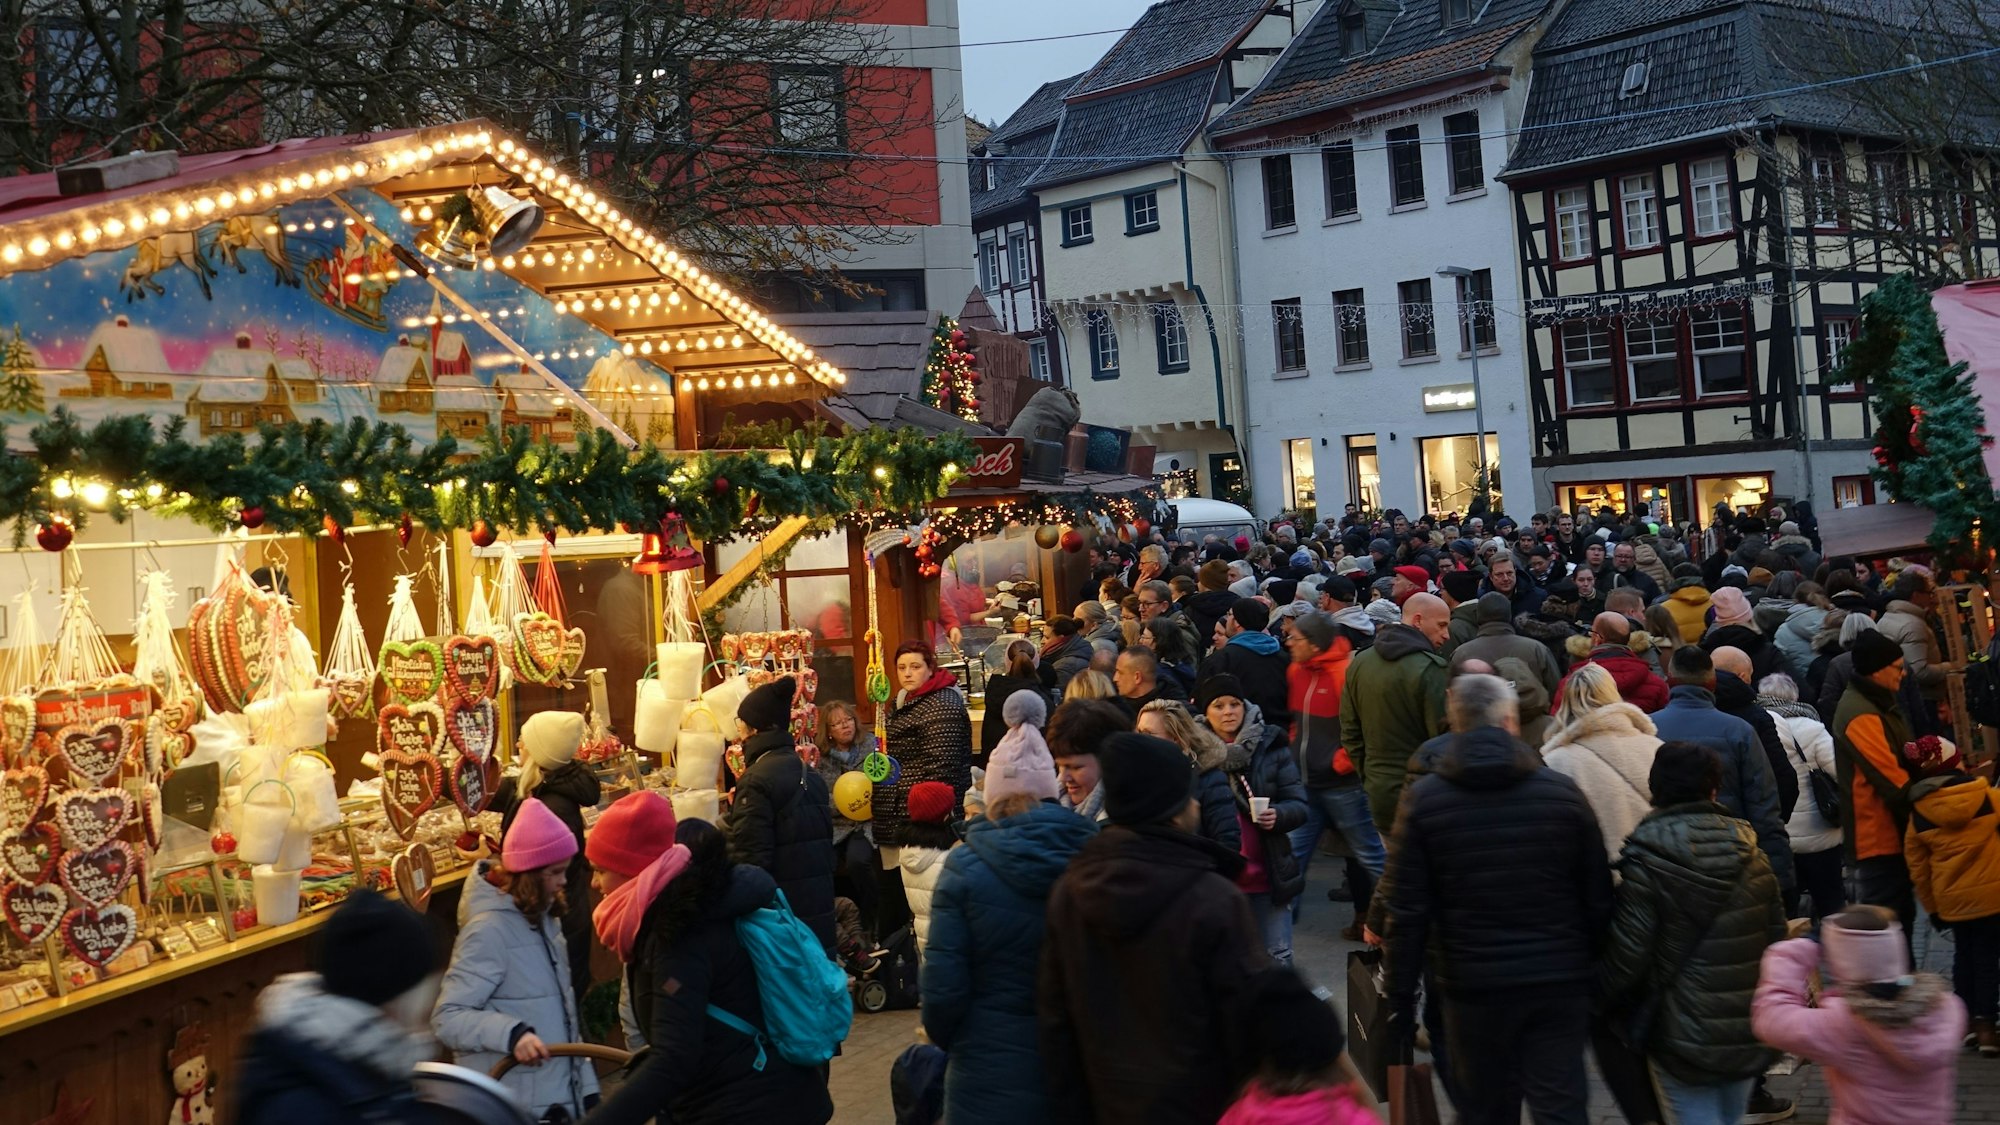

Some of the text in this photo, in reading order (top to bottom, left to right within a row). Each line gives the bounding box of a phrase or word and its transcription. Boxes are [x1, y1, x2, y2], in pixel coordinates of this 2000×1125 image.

[964, 443, 1015, 476] sch
[390, 716, 415, 733] Ich
[398, 770, 419, 782] Ich
[68, 805, 96, 820] Ich
[72, 863, 101, 880] Ich
[10, 898, 33, 913] Ich
[73, 921, 128, 940] Ich liebe
[83, 937, 119, 952] Dich
